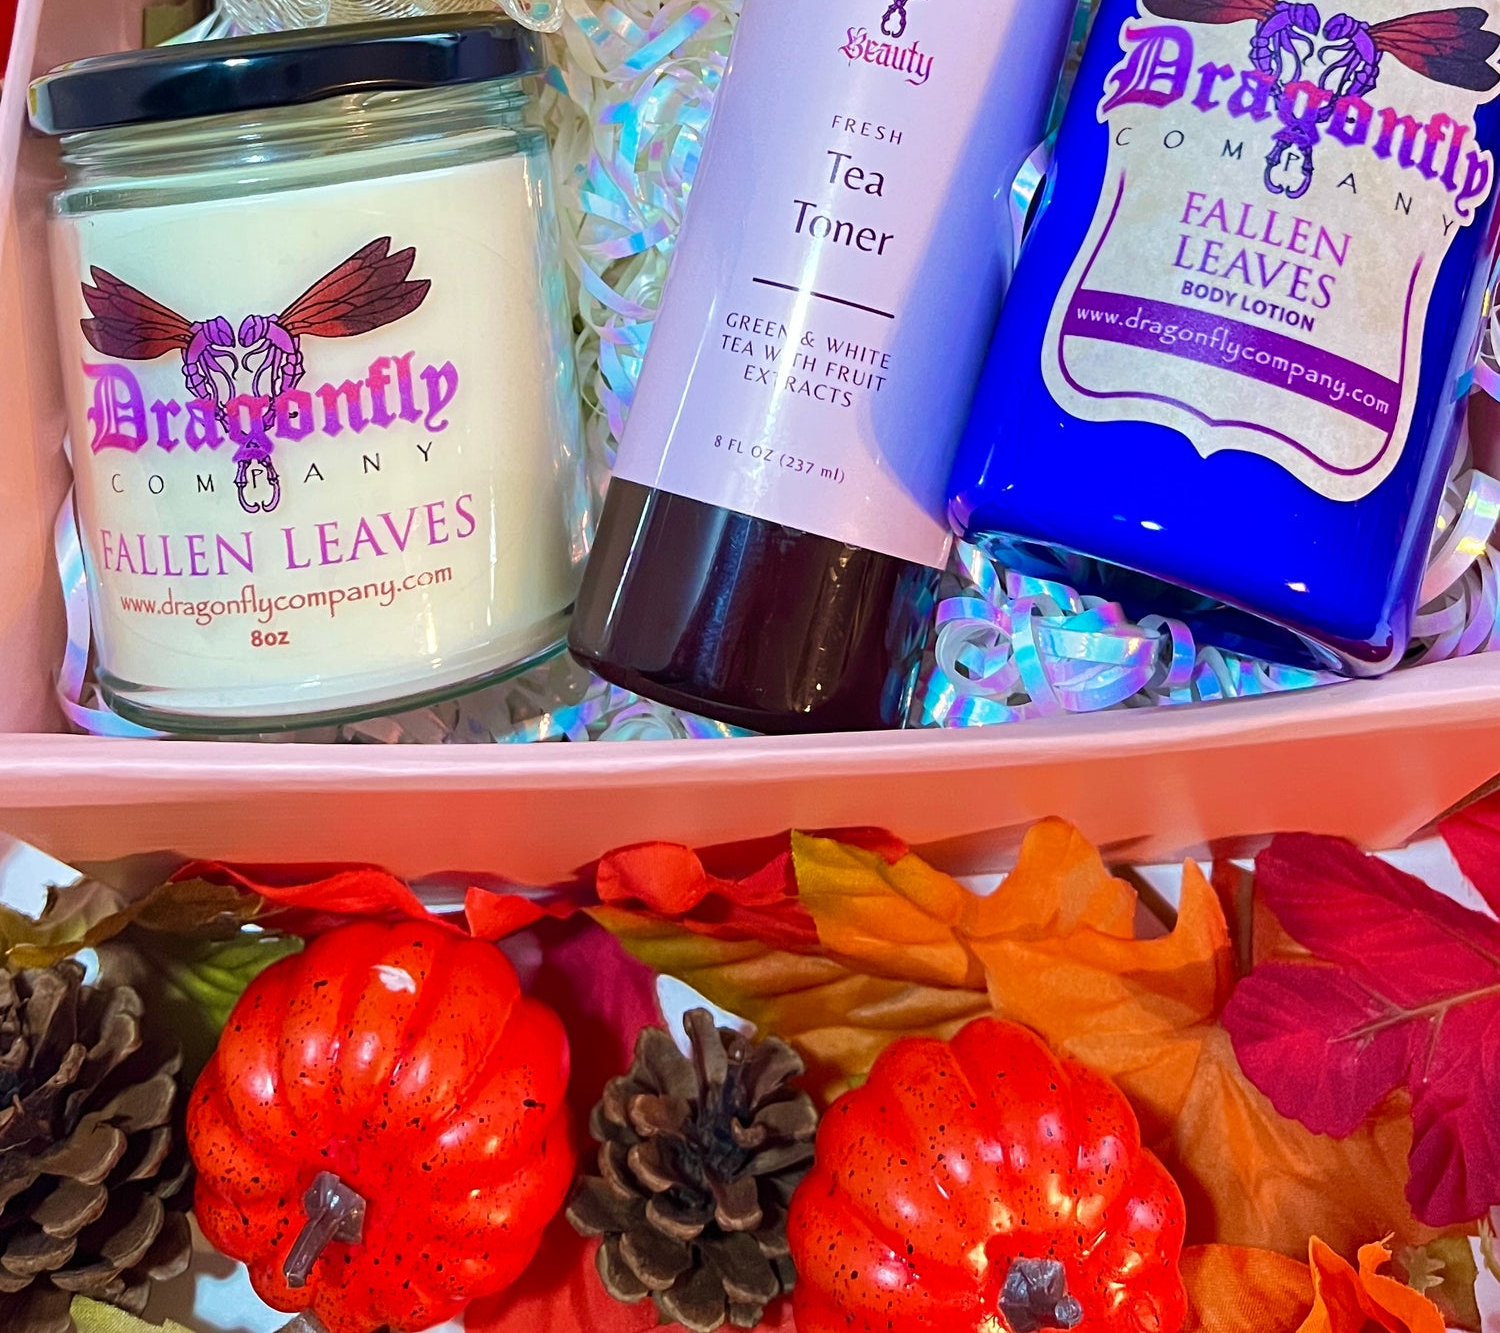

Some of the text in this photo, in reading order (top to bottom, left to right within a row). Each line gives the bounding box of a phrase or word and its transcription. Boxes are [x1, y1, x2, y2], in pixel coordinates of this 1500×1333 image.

[838, 26, 934, 85] Beauty
[832, 115, 902, 145] FRESH
[1102, 25, 1490, 216] Dragonfly
[827, 150, 885, 197] Tea
[1115, 126, 1454, 237] COMPANY
[793, 199, 894, 256] Toner
[1178, 190, 1352, 268] FALLEN
[1171, 233, 1337, 311] LEAVES
[1181, 280, 1314, 333] BODY LOTION
[722, 335, 886, 391] TEA WTH FRUIT
[800, 331, 815, 348] &
[827, 337, 891, 370] WHITE
[1076, 303, 1389, 414] www.dragonflycompany.com
[82, 350, 459, 463] Dragonfly
[112, 442, 434, 494] COMPANY
[714, 435, 845, 484] 8 FL OZ (237 ml)
[101, 494, 477, 577] FALLEN LEAVES
[120, 566, 453, 624] www.dragonflycompany.com
[250, 629, 290, 647] 8oz
